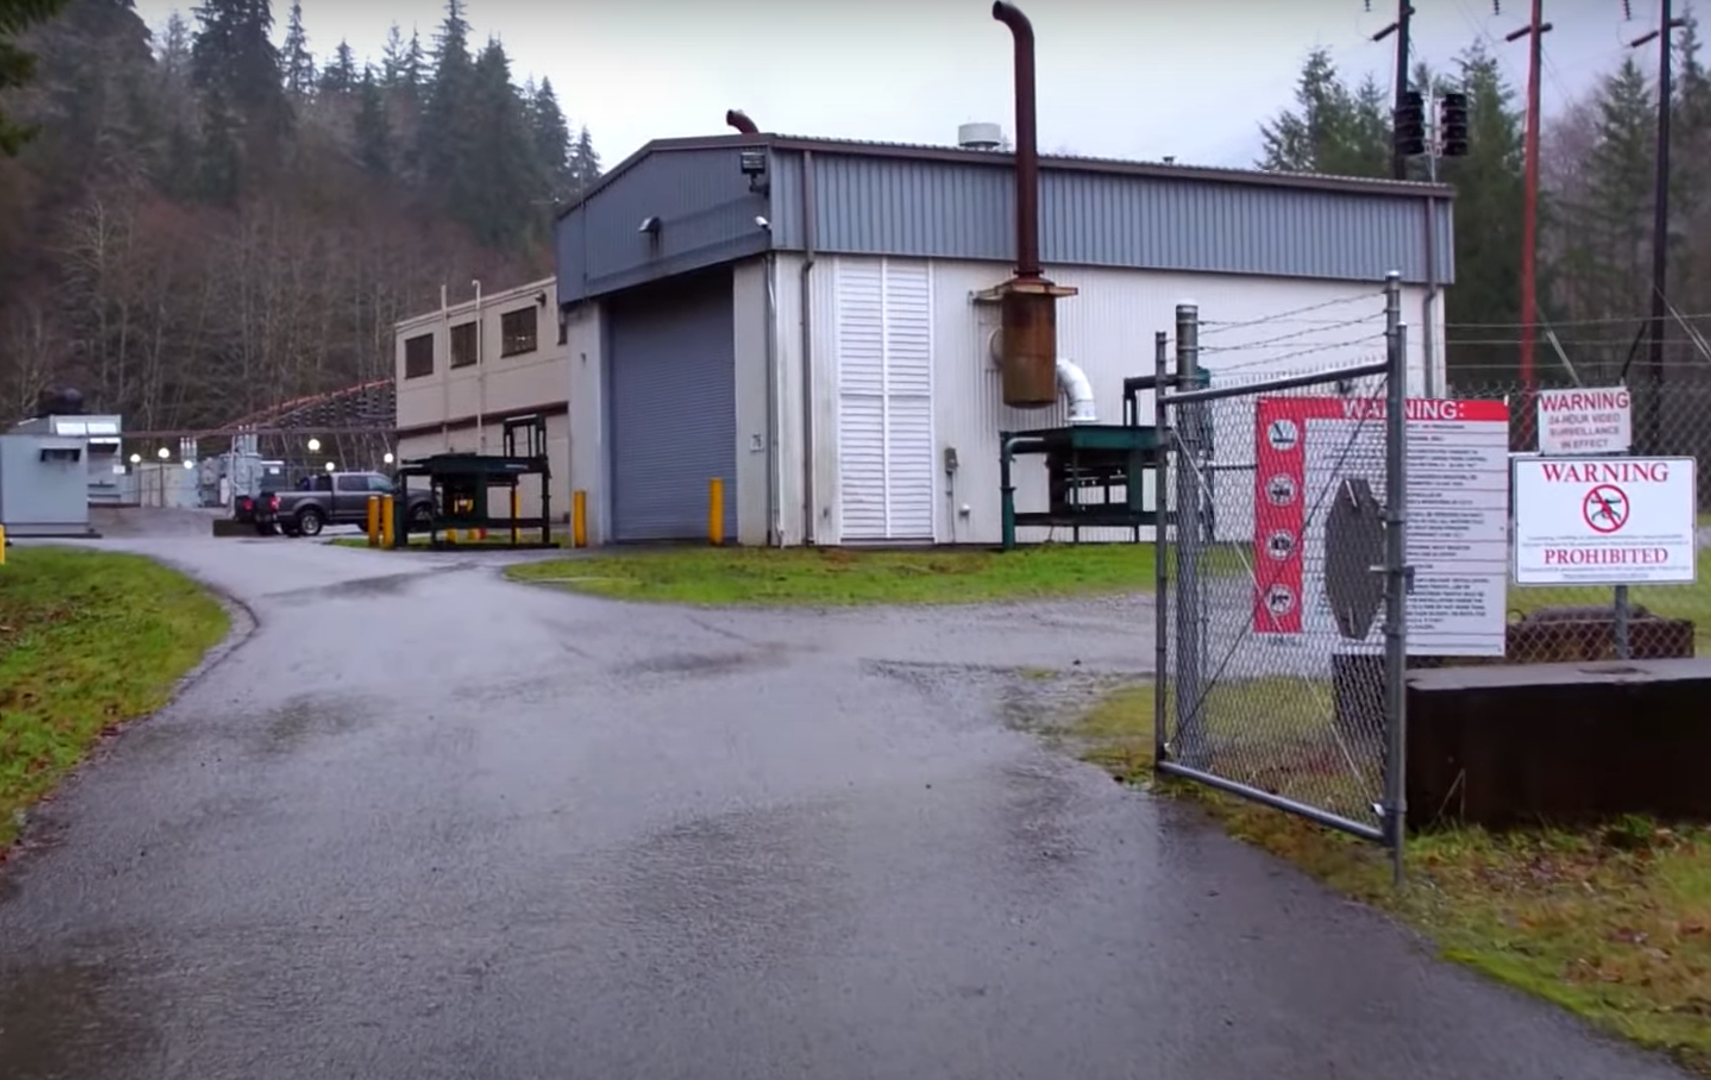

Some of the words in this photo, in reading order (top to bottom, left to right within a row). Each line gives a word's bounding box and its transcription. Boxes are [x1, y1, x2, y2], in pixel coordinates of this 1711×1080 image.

[1342, 399, 1465, 419] WANING:
[1541, 392, 1629, 411] WARNING
[1592, 412, 1621, 423] VIDEO
[1550, 426, 1619, 437] SURVEILLANCE
[1573, 438, 1608, 448] EFFECT
[1542, 463, 1669, 483] WARNING
[1544, 547, 1668, 565] PROHIBITED
